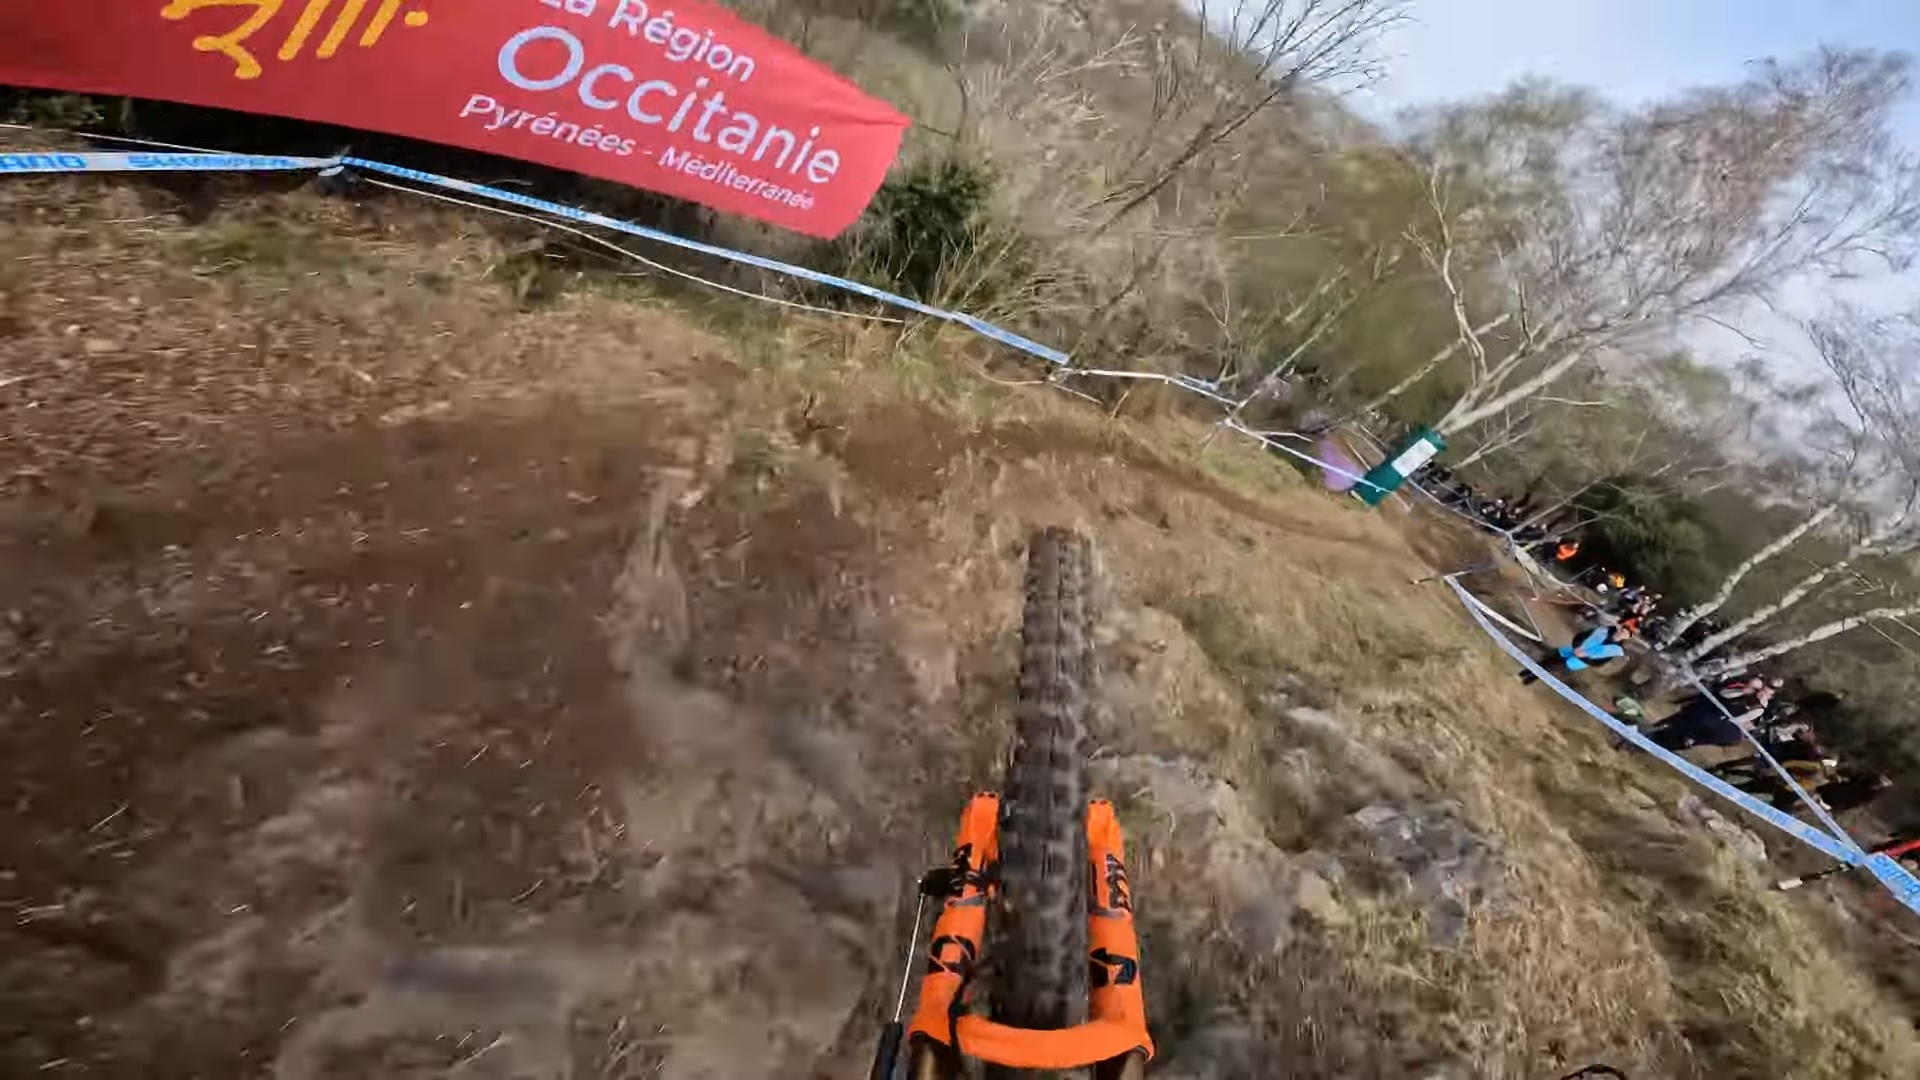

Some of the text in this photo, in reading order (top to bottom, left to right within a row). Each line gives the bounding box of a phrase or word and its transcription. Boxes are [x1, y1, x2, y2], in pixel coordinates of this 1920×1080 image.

[608, 0, 756, 81] Région
[459, 94, 637, 156] Pyrénées
[498, 26, 841, 184] Occitanie
